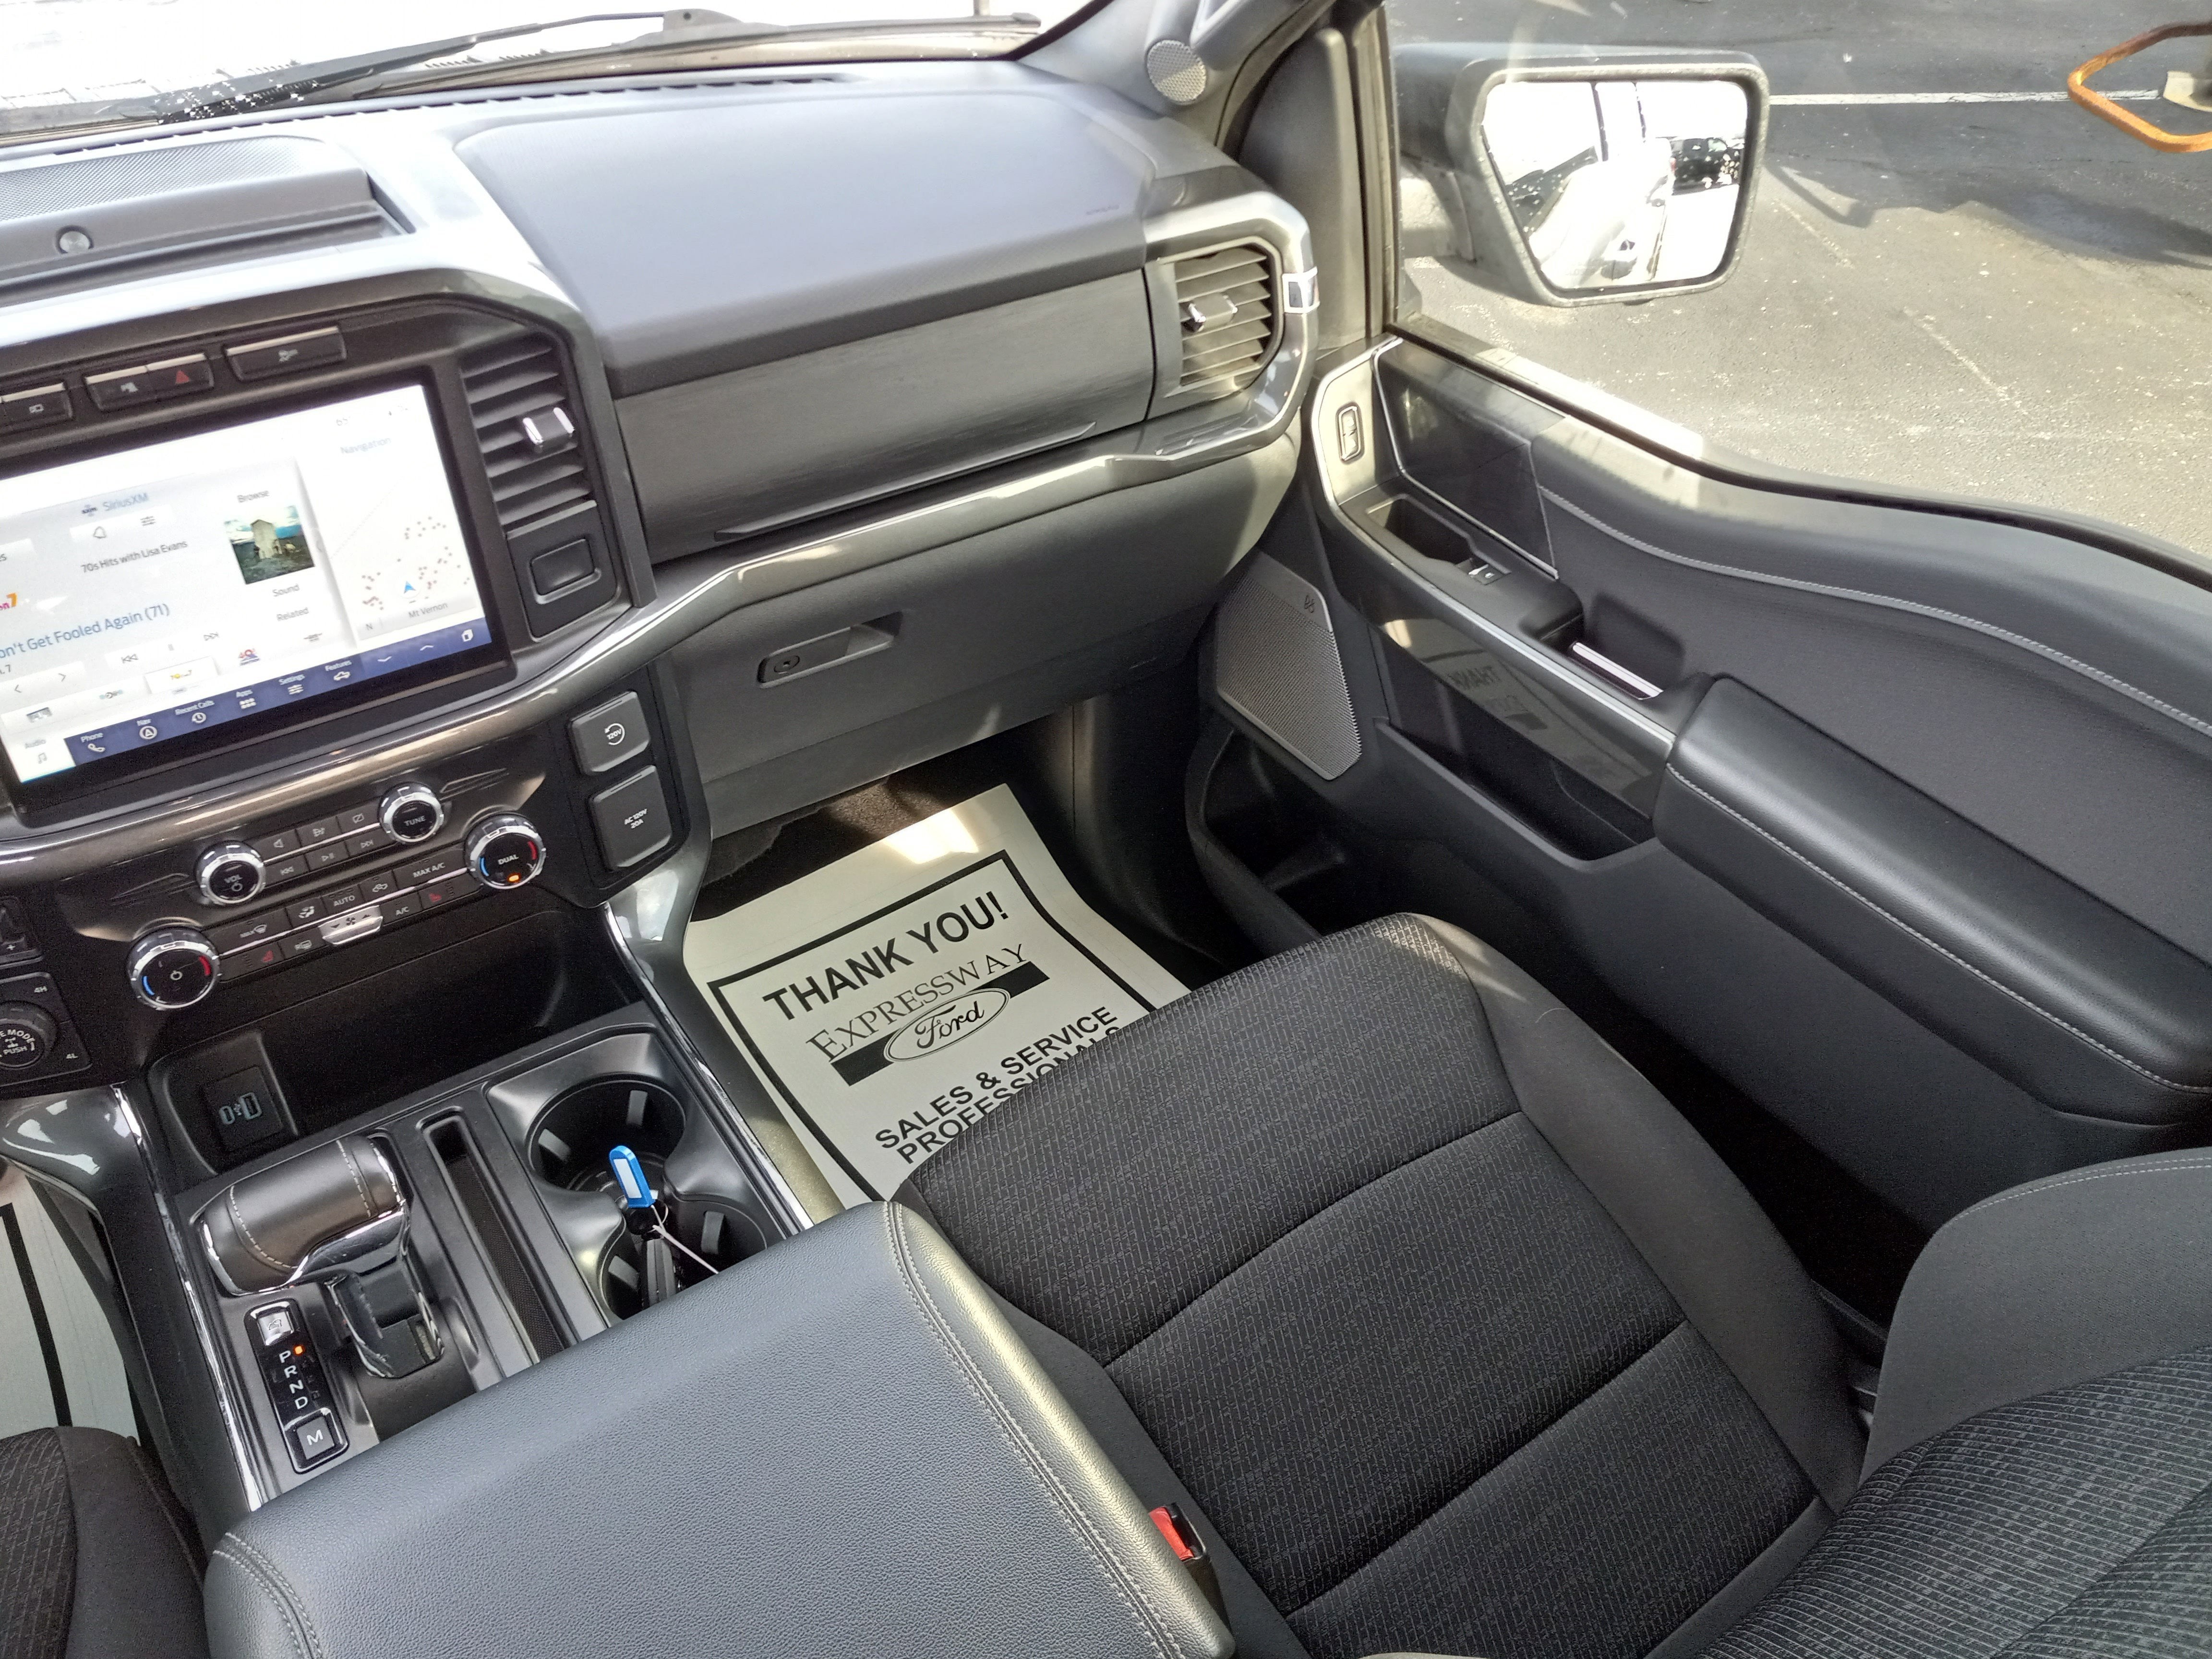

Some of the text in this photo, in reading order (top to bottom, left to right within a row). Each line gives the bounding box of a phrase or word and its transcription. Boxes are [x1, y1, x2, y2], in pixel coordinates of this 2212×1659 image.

[237, 490, 270, 503] Browse
[81, 541, 188, 573] 70s Hits with Lisa Evans
[272, 584, 300, 597] Sound
[276, 606, 310, 622] Related
[408, 601, 448, 618] Mt Vernon
[27, 636, 54, 650] Get
[54, 621, 102, 643] Fooled
[104, 611, 143, 629] Again
[144, 603, 171, 621] (71)
[325, 661, 352, 672] Features
[278, 673, 305, 685] Settings
[80, 732, 104, 743] Phone
[607, 729, 621, 740] 120V
[404, 816, 426, 826] TUNE
[625, 809, 647, 825] AC 120V
[631, 819, 644, 829] 20A
[497, 854, 519, 865] DUAL
[412, 862, 445, 878] MAX A/C
[224, 873, 243, 884] VOL
[333, 895, 355, 907] AUTO
[396, 906, 409, 916] A/C
[762, 890, 1009, 1021] THANK YOU!
[805, 943, 1028, 1062] EXPRESSWAY
[916, 1000, 986, 1050] Ford
[7, 1029, 35, 1043] MODE
[3, 1046, 27, 1055] PUSH
[875, 1006, 1118, 1148] SALES & SERVICE
[279, 1350, 291, 1363] P
[284, 1365, 298, 1378] R
[289, 1380, 303, 1394] N
[295, 1396, 308, 1409] D
[307, 1429, 323, 1445] M
